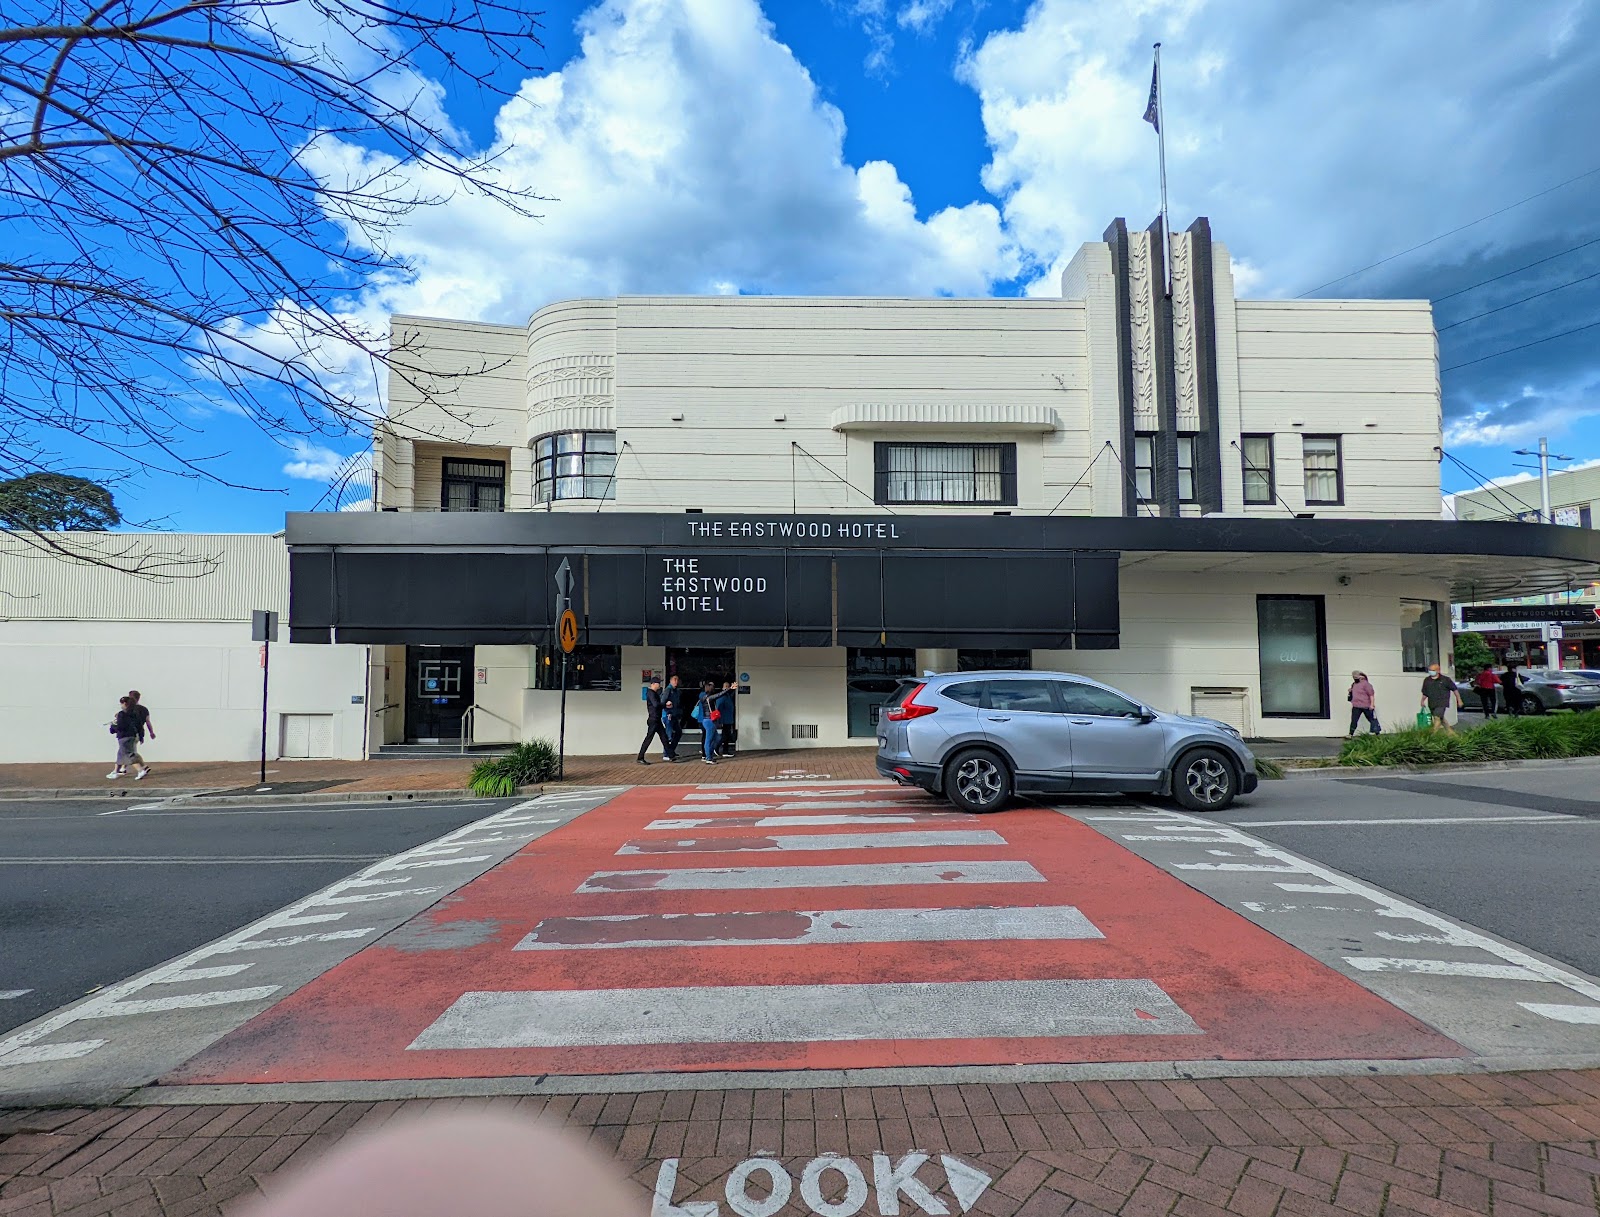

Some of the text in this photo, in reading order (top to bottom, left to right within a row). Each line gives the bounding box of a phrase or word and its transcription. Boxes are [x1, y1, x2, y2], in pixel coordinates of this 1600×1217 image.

[687, 522, 899, 538] THE EASTWOOD HOTEL
[662, 558, 699, 573] THE
[661, 577, 767, 592] EASTWOOD
[661, 596, 724, 611] HOTEL
[650, 1149, 951, 1217] LOOK
